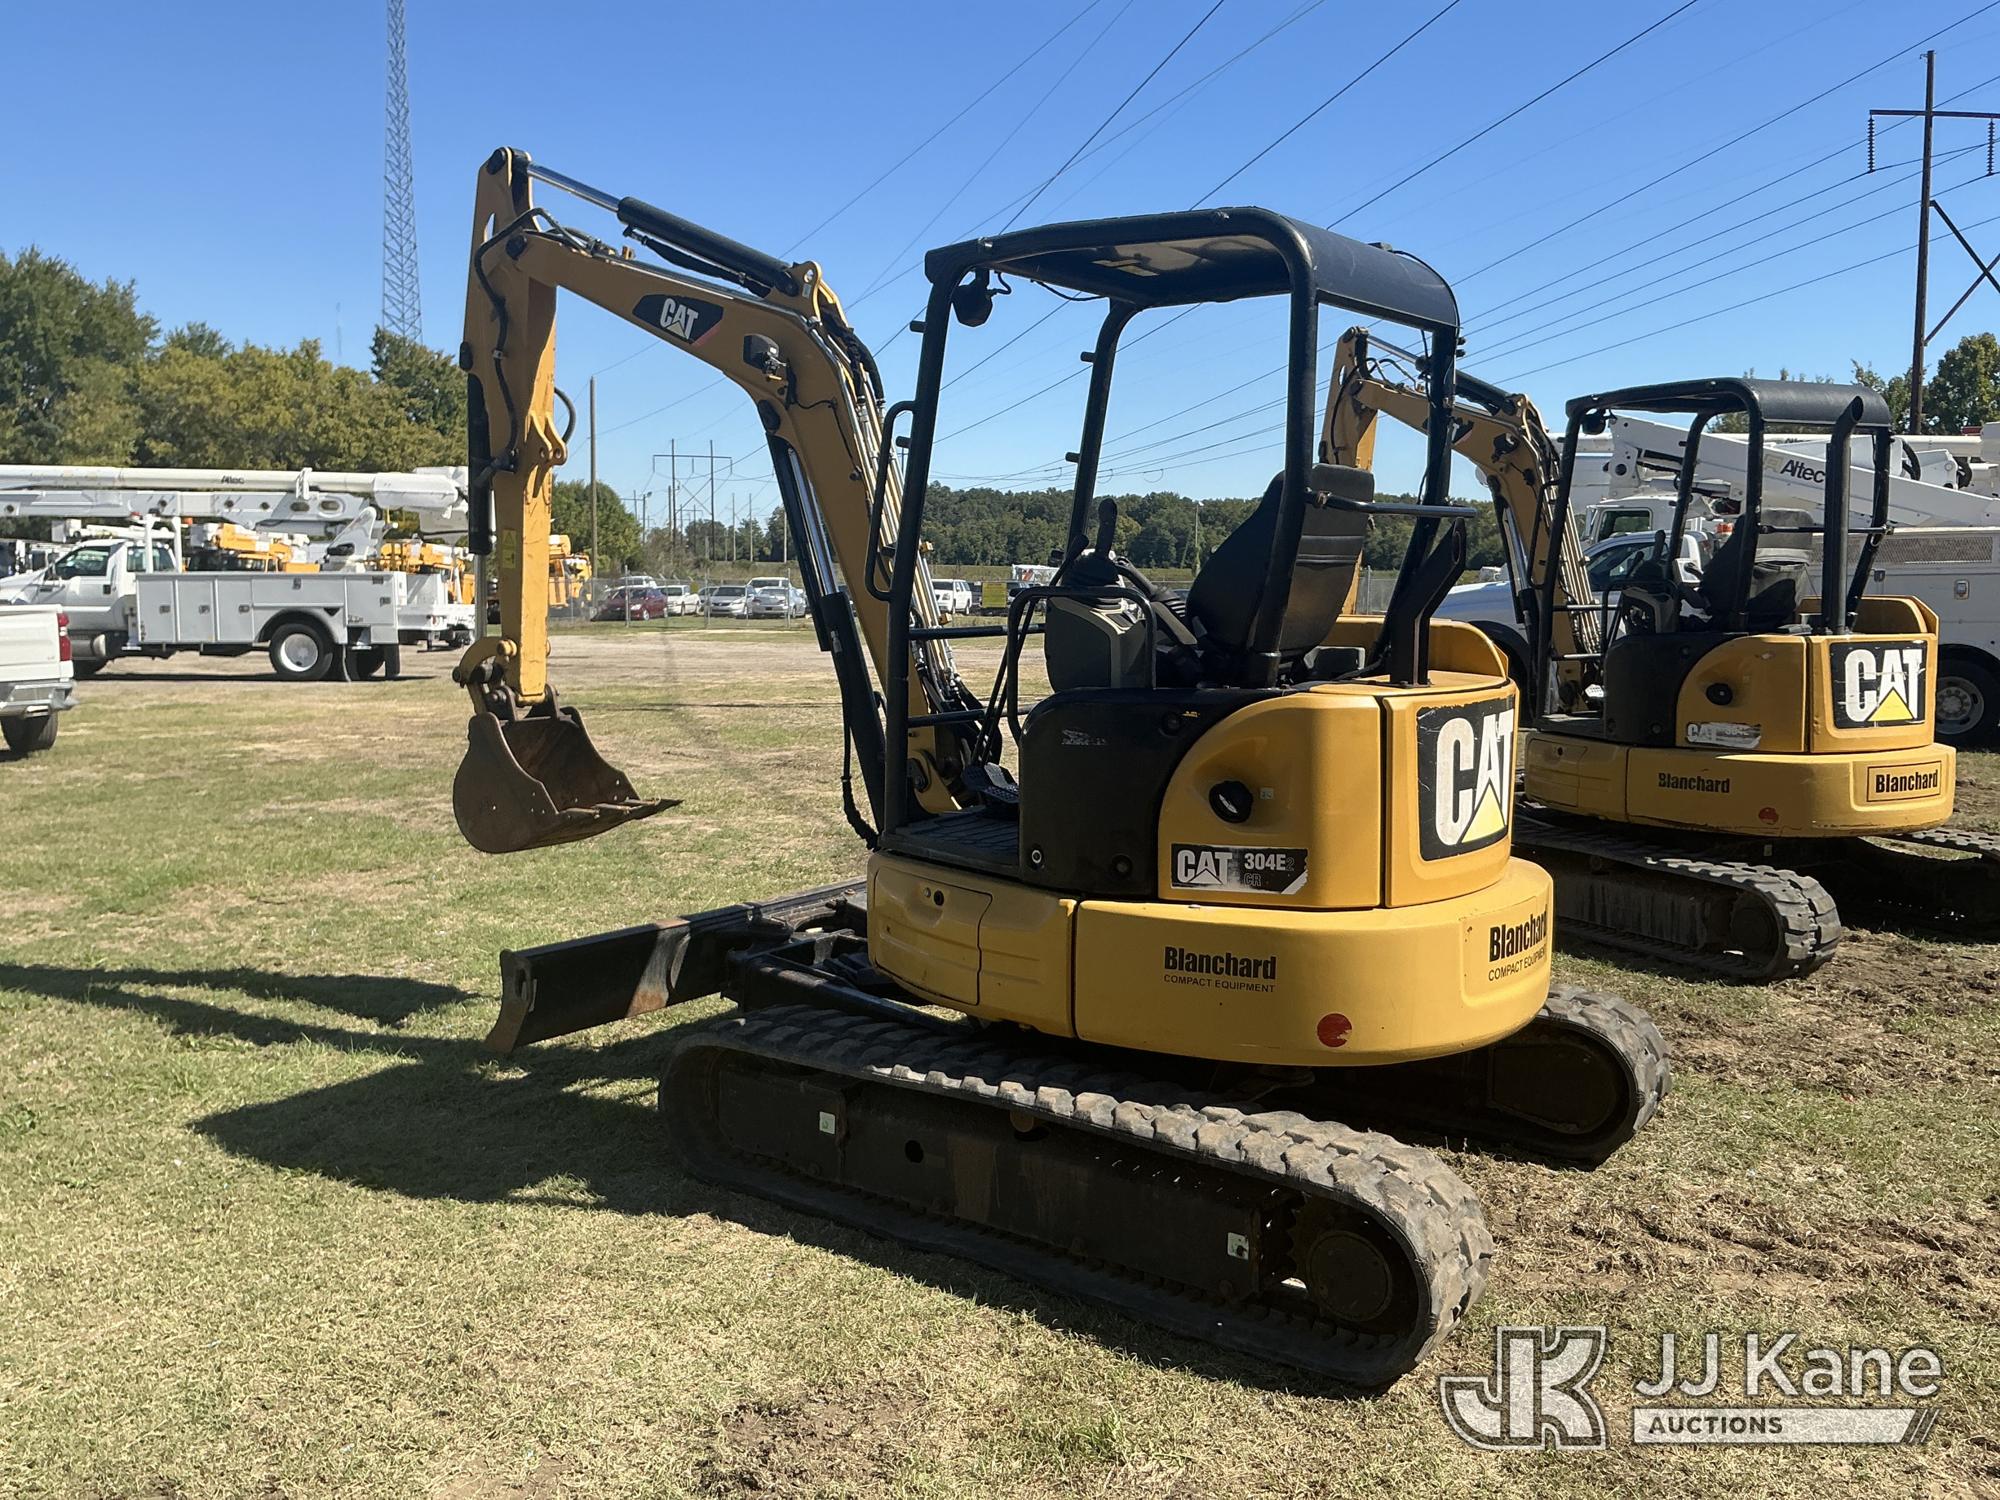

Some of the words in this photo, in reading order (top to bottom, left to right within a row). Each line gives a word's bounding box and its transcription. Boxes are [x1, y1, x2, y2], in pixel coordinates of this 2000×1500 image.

[660, 298, 699, 340] CAT
[1780, 459, 1826, 483] Altec
[1845, 649, 1922, 722] CAT
[1436, 709, 1514, 846] CAT
[1658, 772, 1730, 793] Blanchard
[1876, 769, 1938, 793] Blanchard
[1177, 850, 1233, 885] CAT
[1244, 873, 1262, 886] CR
[1490, 904, 1547, 962] Blanchard
[1164, 946, 1276, 979] Blanchard
[1488, 960, 1523, 981] COMPACT
[1164, 974, 1211, 987] COMPACT
[1215, 980, 1276, 993] EQUIPMENT
